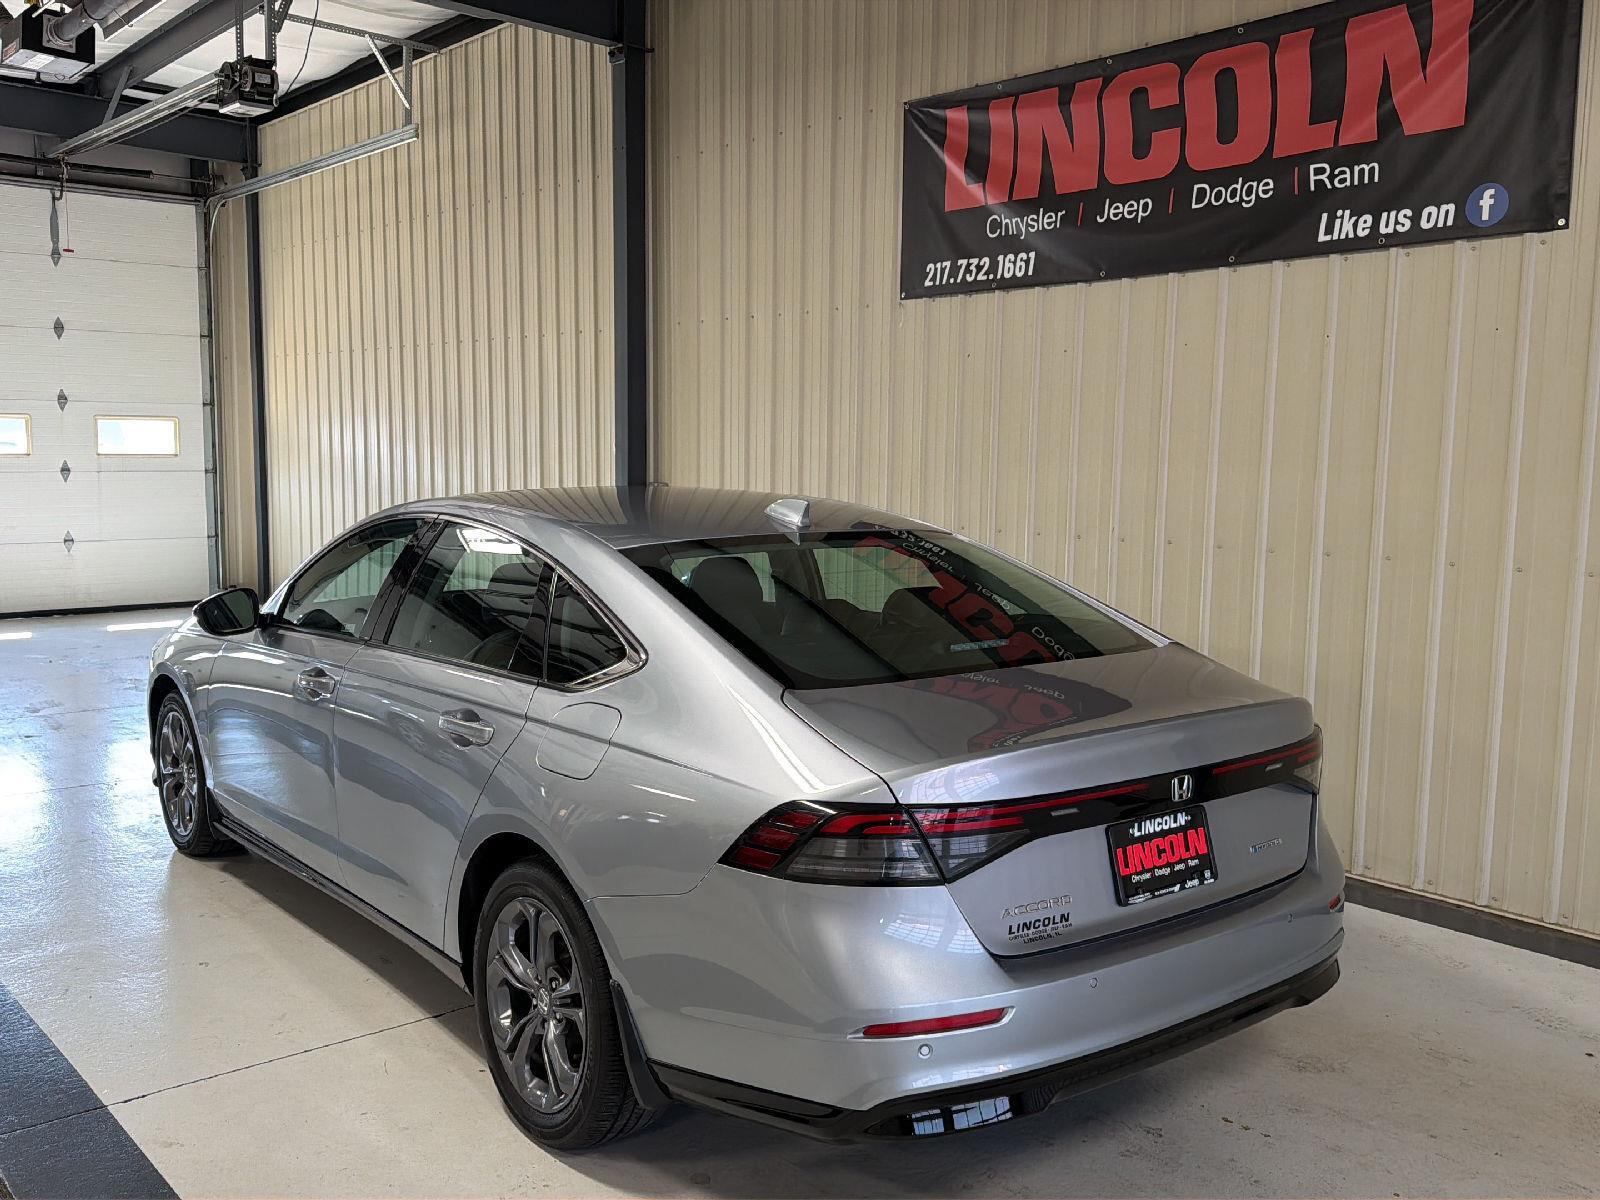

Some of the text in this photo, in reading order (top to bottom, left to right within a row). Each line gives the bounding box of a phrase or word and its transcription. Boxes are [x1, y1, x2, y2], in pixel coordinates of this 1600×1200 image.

[944, 0, 1474, 212] LINCOLN
[986, 162, 1380, 240] Chrysler Jeep Dodge Ram
[1317, 209, 1371, 243] Like
[1379, 207, 1412, 235] us
[1420, 201, 1456, 229] on
[924, 250, 1037, 288] 217.732.1661
[1133, 811, 1187, 837] LINCOLN
[1116, 827, 1208, 877] LINCOLN
[1001, 894, 1073, 920] ACCORD
[1008, 911, 1070, 936] LINCOLN
